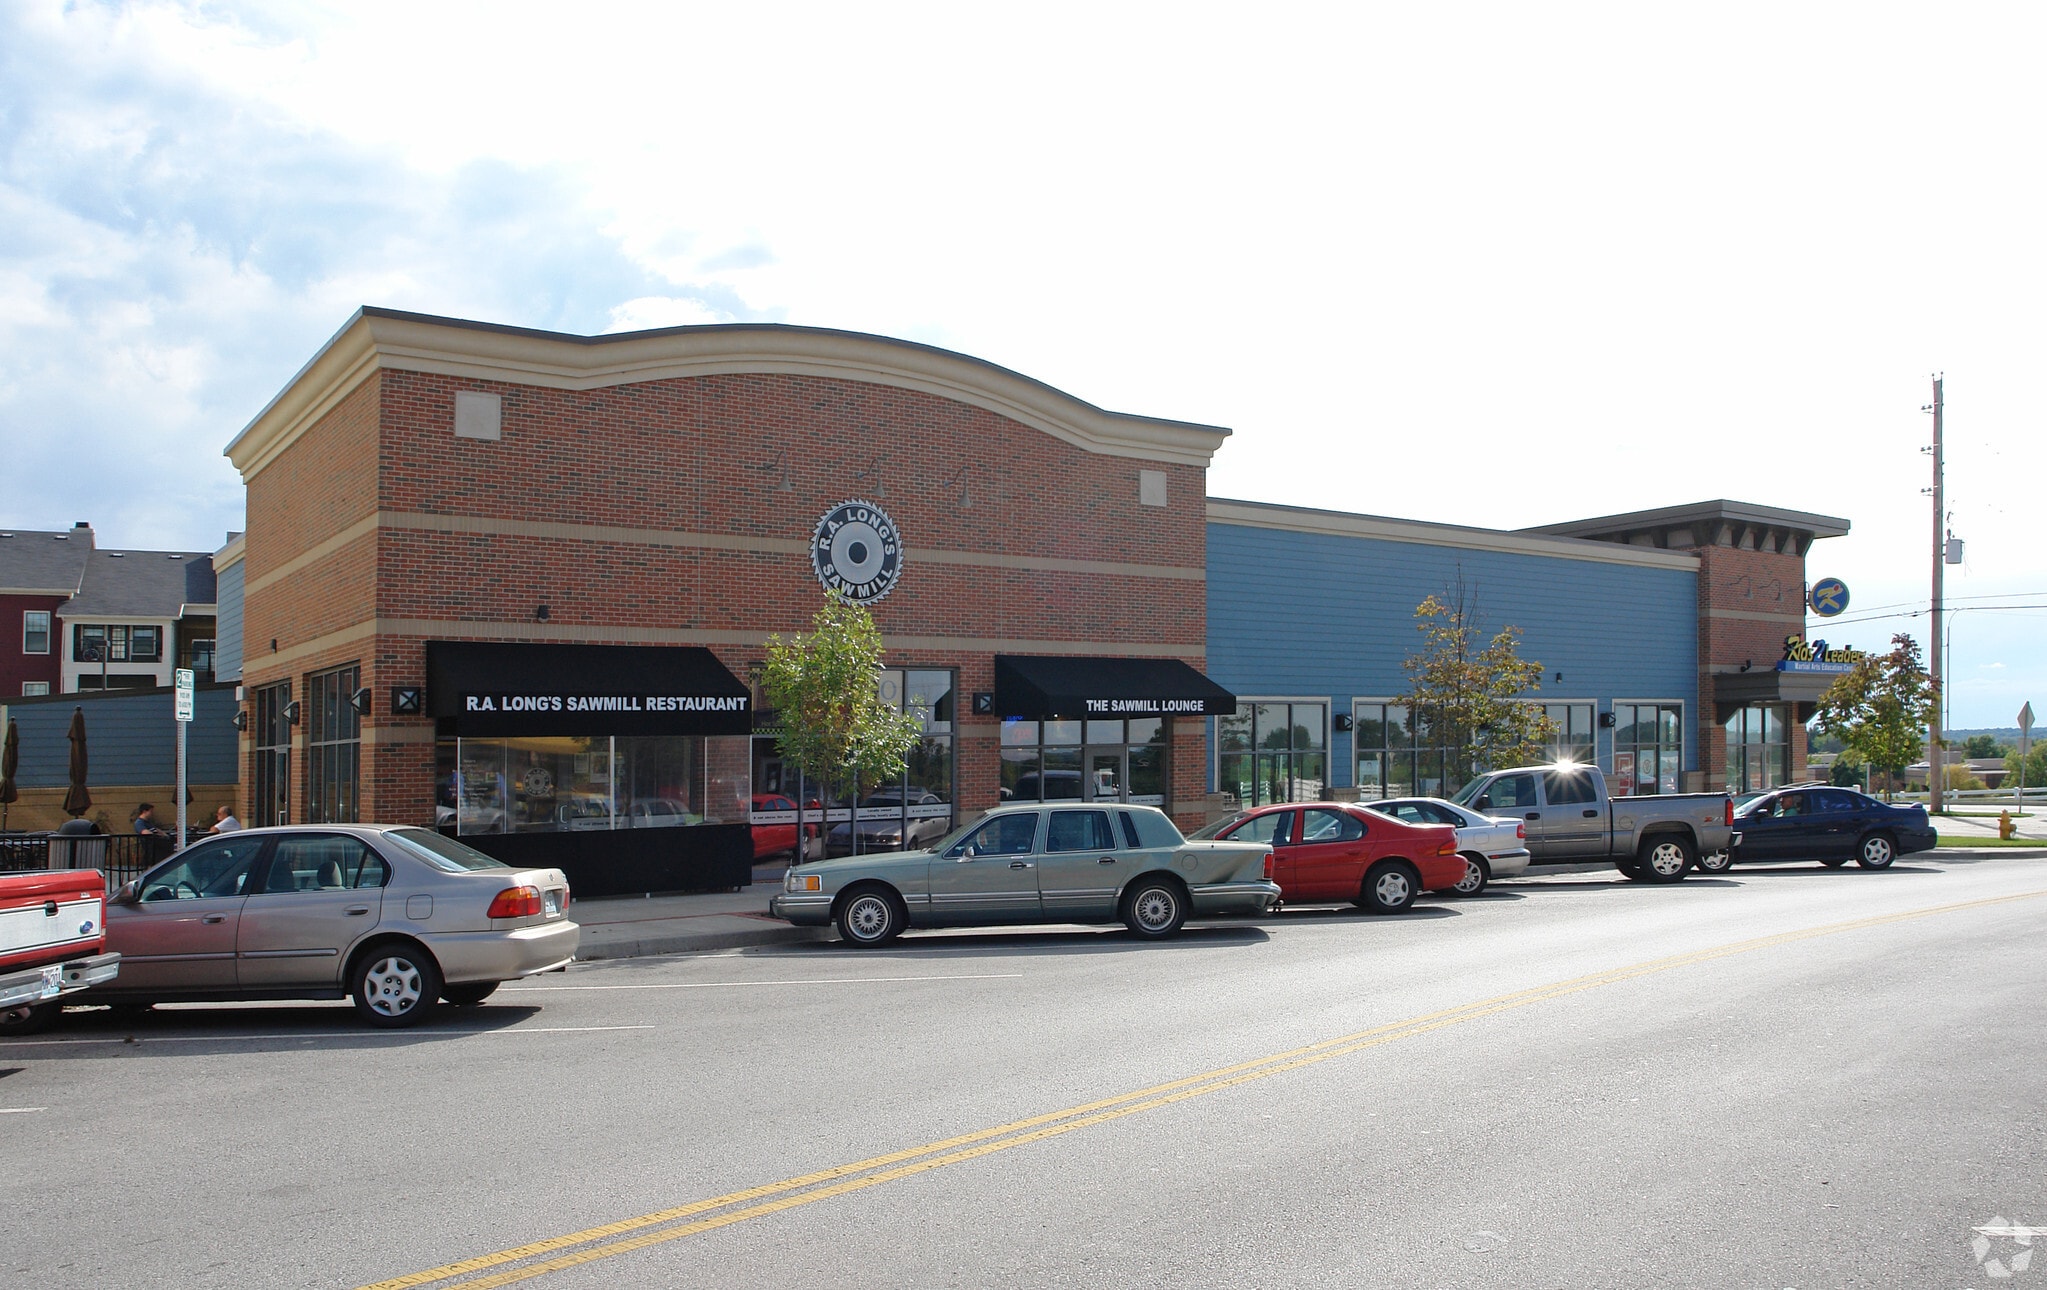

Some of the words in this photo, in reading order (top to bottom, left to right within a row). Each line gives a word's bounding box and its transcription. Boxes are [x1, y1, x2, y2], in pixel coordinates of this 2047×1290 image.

[818, 520, 844, 551] R.A.
[846, 508, 896, 556] LONG'S
[822, 563, 893, 598] SAWMILL
[1824, 643, 1866, 664] Leader
[1811, 662, 1821, 671] Arts
[1821, 663, 1843, 671] Education
[466, 696, 497, 711] R.A.
[501, 696, 562, 711] LONG'S
[567, 696, 641, 711] SAWMILL
[646, 696, 747, 711] RESTAURANT
[1086, 699, 1109, 712] THE
[1111, 699, 1160, 712] SAWMILL
[1161, 699, 1204, 712] LOUNGE
